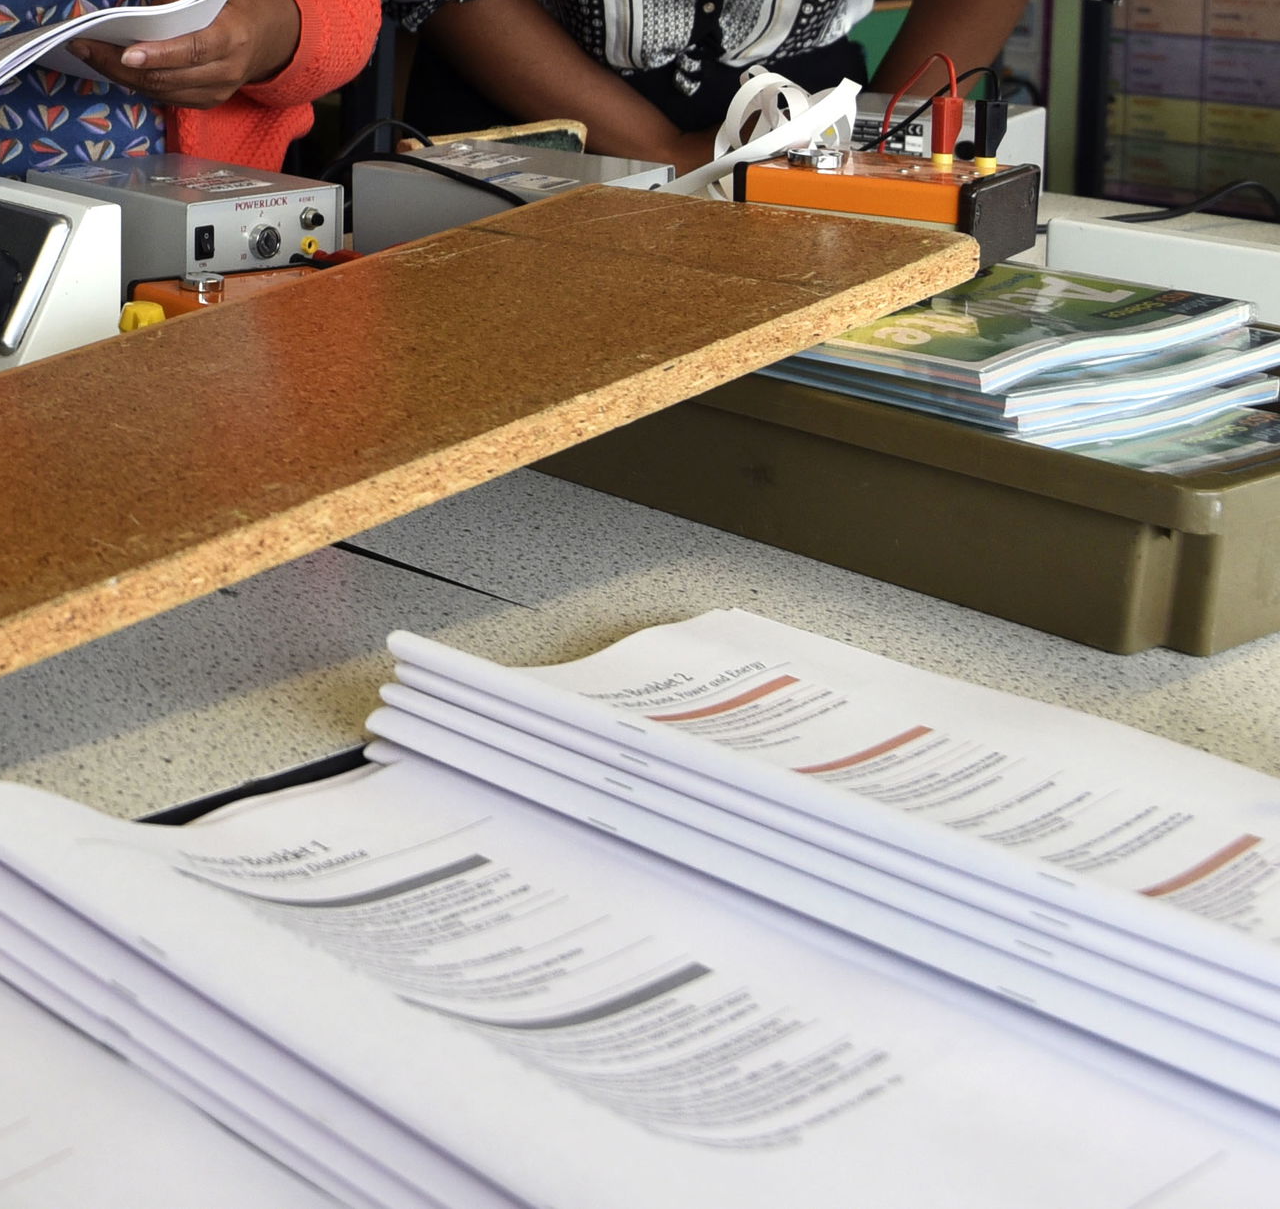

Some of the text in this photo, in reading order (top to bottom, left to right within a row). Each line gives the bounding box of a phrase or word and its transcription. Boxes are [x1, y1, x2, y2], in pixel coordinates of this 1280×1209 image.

[235, 196, 288, 212] POWERLOCK
[622, 678, 677, 699] Booklet
[674, 672, 694, 683] 2
[708, 675, 731, 688] and
[725, 661, 767, 679] Energy
[240, 843, 313, 866] Booklet
[305, 848, 369, 873] Distance
